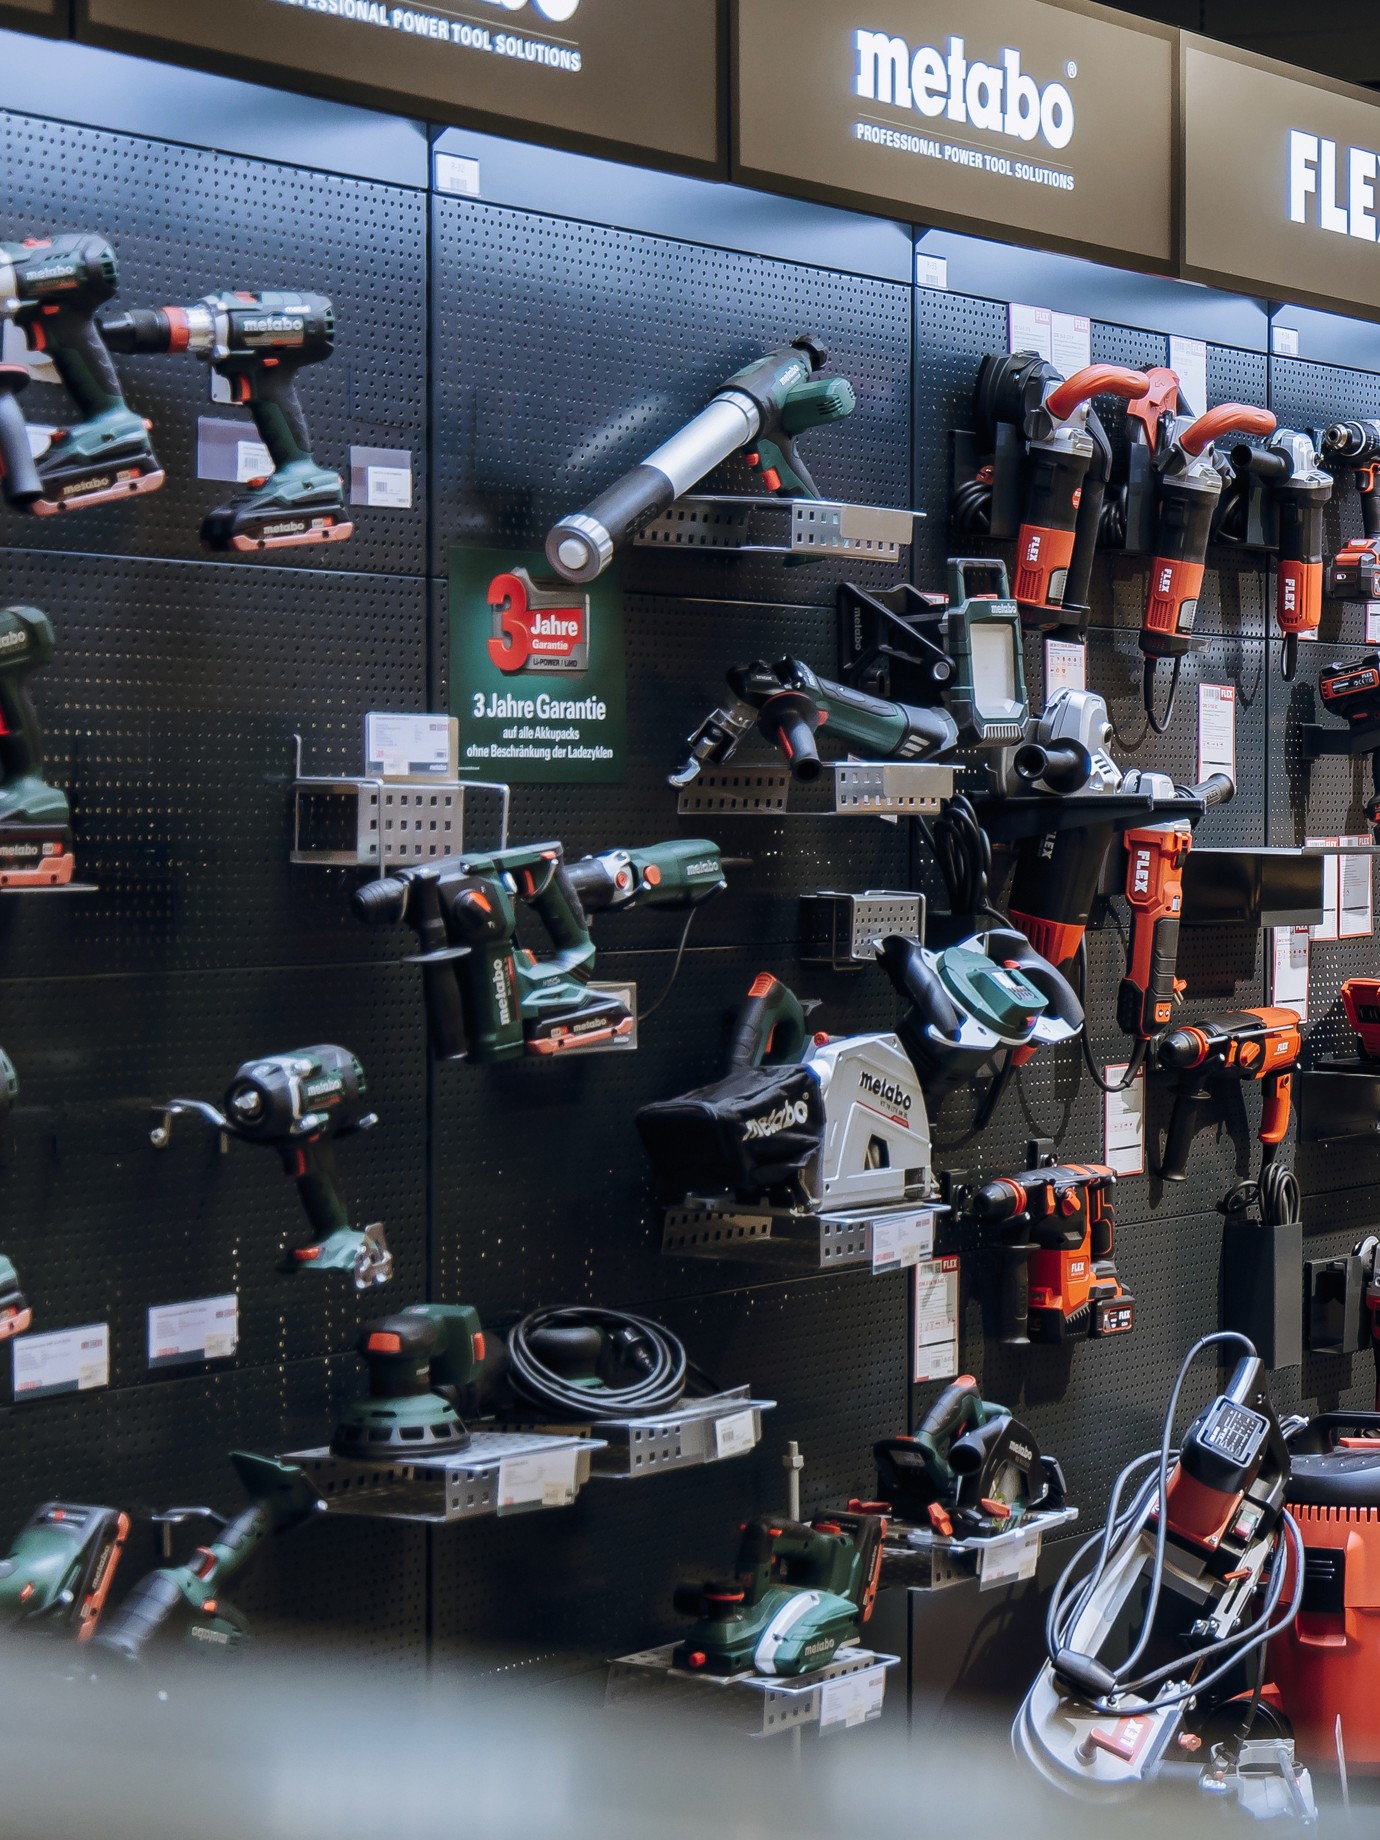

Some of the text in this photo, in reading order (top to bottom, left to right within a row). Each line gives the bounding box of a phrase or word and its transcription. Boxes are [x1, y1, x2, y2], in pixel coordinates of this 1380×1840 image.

[393, 8, 449, 41] POWER
[451, 24, 492, 51] TOOL
[495, 35, 582, 72] SOLUTIONS
[856, 29, 1075, 149] metabo
[856, 123, 1075, 190] PROFESSIONAL POWER TOOL SOLUTIONS
[26, 265, 75, 281] metabo
[243, 316, 304, 332] metabo
[63, 477, 109, 496] metabo
[263, 521, 305, 536] metabo
[1030, 536, 1040, 562] FLEX
[1161, 568, 1172, 593] FLEX
[1285, 578, 1295, 611] FLEX
[990, 602, 1018, 614] metabo
[487, 573, 578, 671] 3 Jahre
[854, 606, 862, 651] metabo
[0, 630, 26, 648] abo
[532, 639, 569, 650] Garantie
[1221, 690, 1233, 699] FLEX
[473, 692, 607, 720] 3 Jahre Garantie
[503, 726, 580, 742] auf alle Akkupacks
[466, 744, 614, 761] ohne Beschränkung der Ladezyklen
[1040, 832, 1057, 860] LEX
[686, 862, 719, 876] metabo
[1134, 850, 1151, 893] FLEX
[493, 959, 510, 1026] metabo
[573, 1017, 607, 1032] metabo
[307, 1080, 342, 1096] metabo
[859, 1071, 912, 1111] metabo
[742, 1098, 808, 1141] metabo
[943, 1259, 957, 1270] FLEX
[1071, 1262, 1085, 1273] FLEX
[1118, 1310, 1131, 1320] FLEX
[1010, 1440, 1033, 1461] metabo
[804, 1638, 835, 1657] metabo
[1121, 1718, 1144, 1747] LEX
